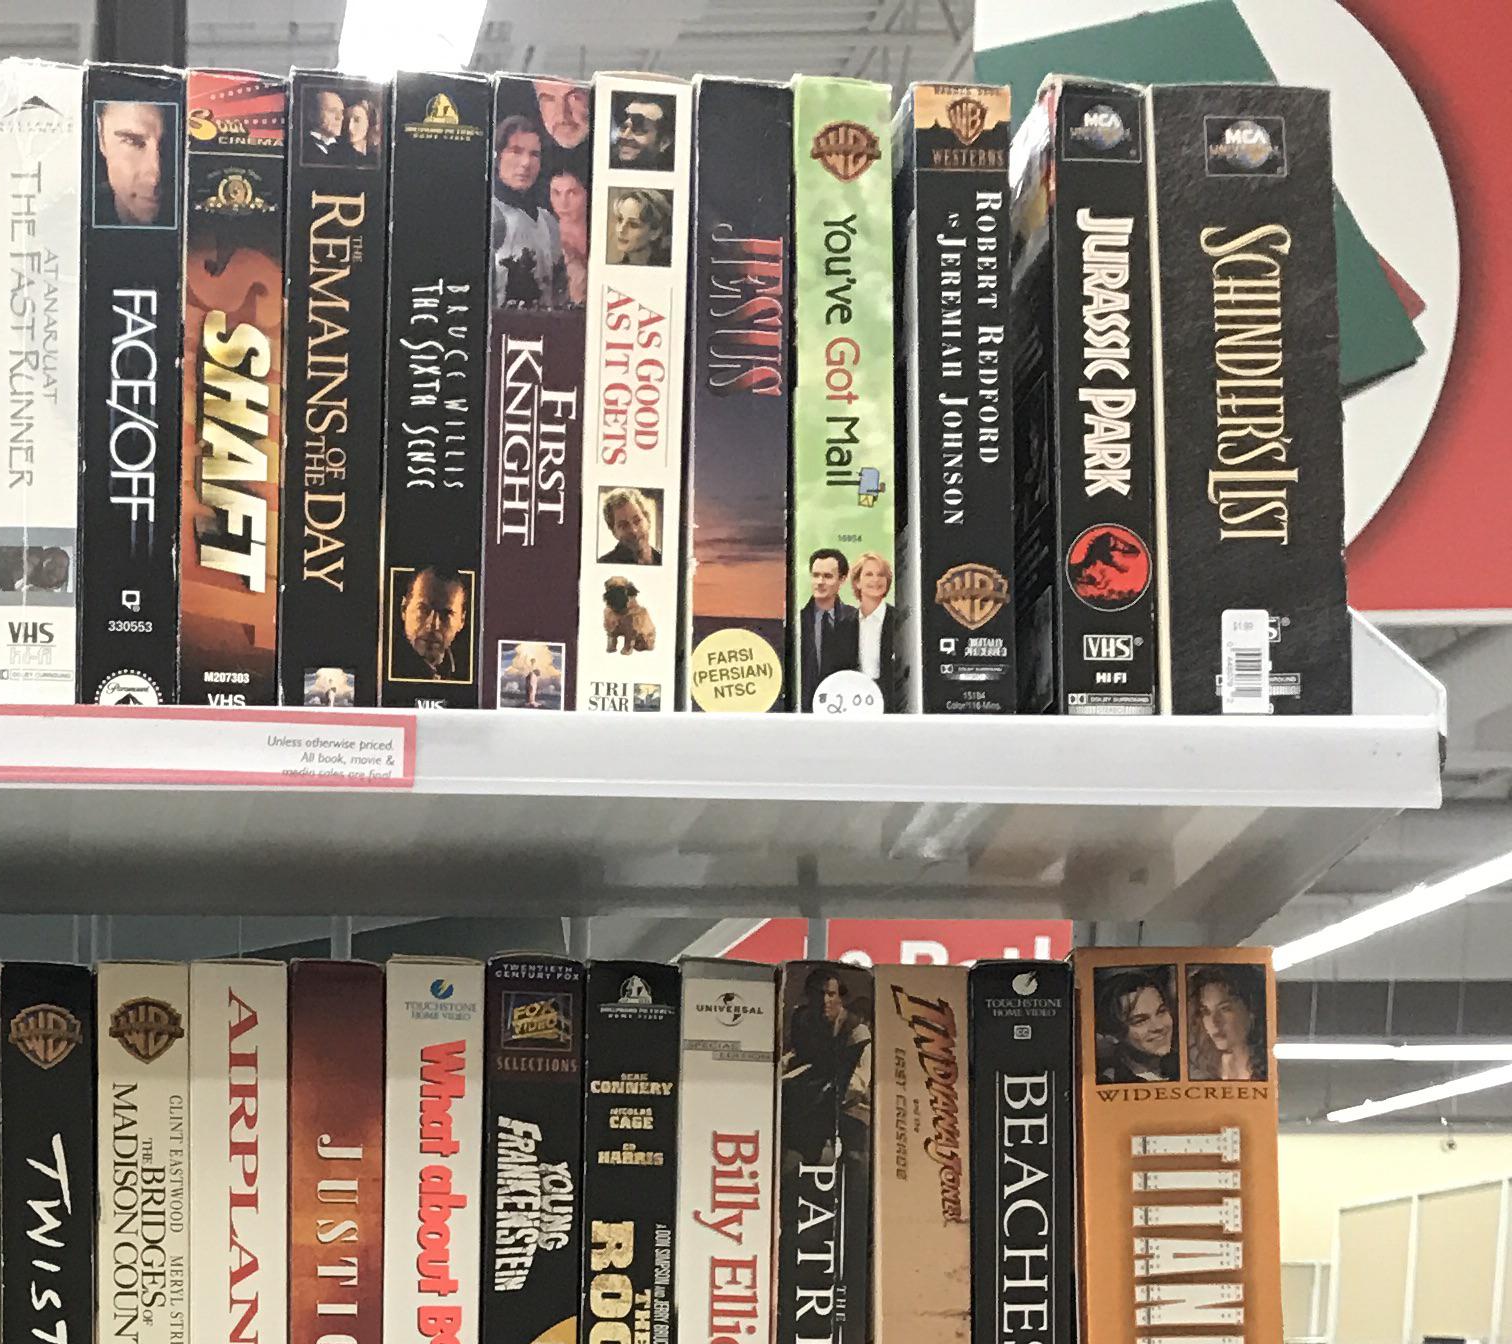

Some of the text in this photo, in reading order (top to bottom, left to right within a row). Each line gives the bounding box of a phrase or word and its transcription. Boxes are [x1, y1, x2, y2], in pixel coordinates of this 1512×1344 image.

[307, 192, 364, 434] REMAINS
[823, 212, 861, 487] You've Got Mail
[975, 190, 1004, 464] ROBERT REDFORD
[1076, 208, 1136, 498] JURASSIC PARK
[110, 289, 158, 522] FACE/OFF
[937, 226, 968, 525] JEREMIAH JOHNSON
[1200, 223, 1298, 546] SCHINDLER'S LIST
[200, 311, 271, 593] SHAFT
[303, 492, 347, 591] DAY
[109, 621, 152, 633] 330553
[692, 662, 773, 687] (PERSIAN)
[707, 648, 754, 664] FARSI
[1085, 636, 1132, 659] VHS
[713, 681, 757, 699] NTSC
[590, 1080, 674, 1096] CONNERY
[1096, 1087, 1268, 1102] WIDESCREEN
[693, 1130, 760, 1246] Billy
